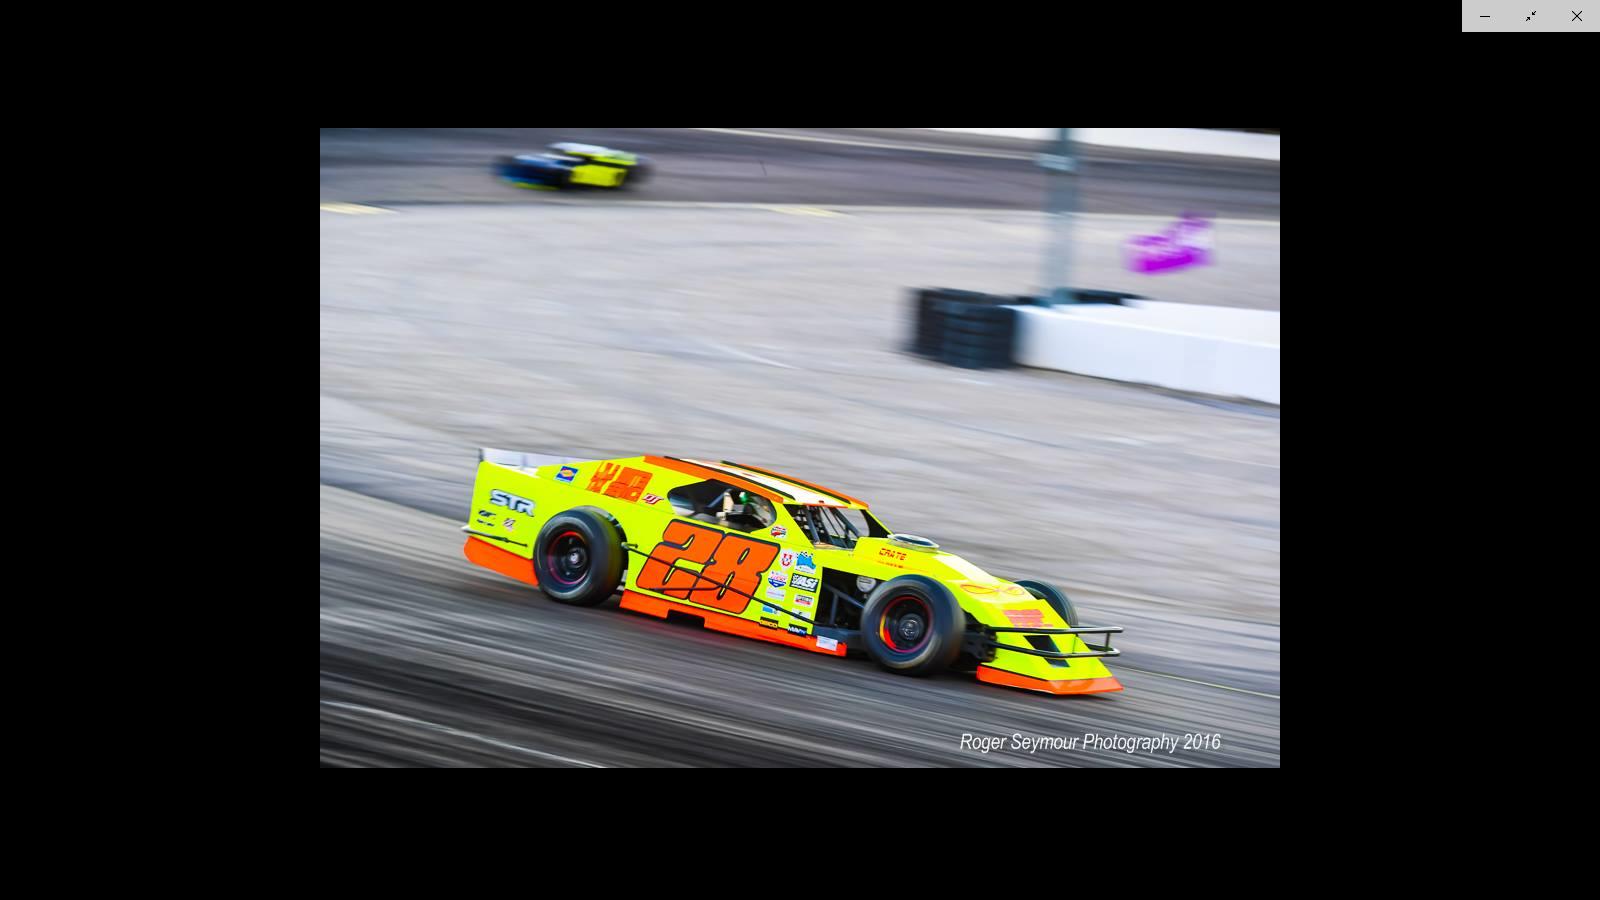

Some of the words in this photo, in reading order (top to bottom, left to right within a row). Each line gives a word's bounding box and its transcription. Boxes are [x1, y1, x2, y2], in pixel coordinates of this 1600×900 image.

[489, 488, 535, 518] STR
[636, 518, 781, 615] 28
[879, 547, 907, 561] CRATE
